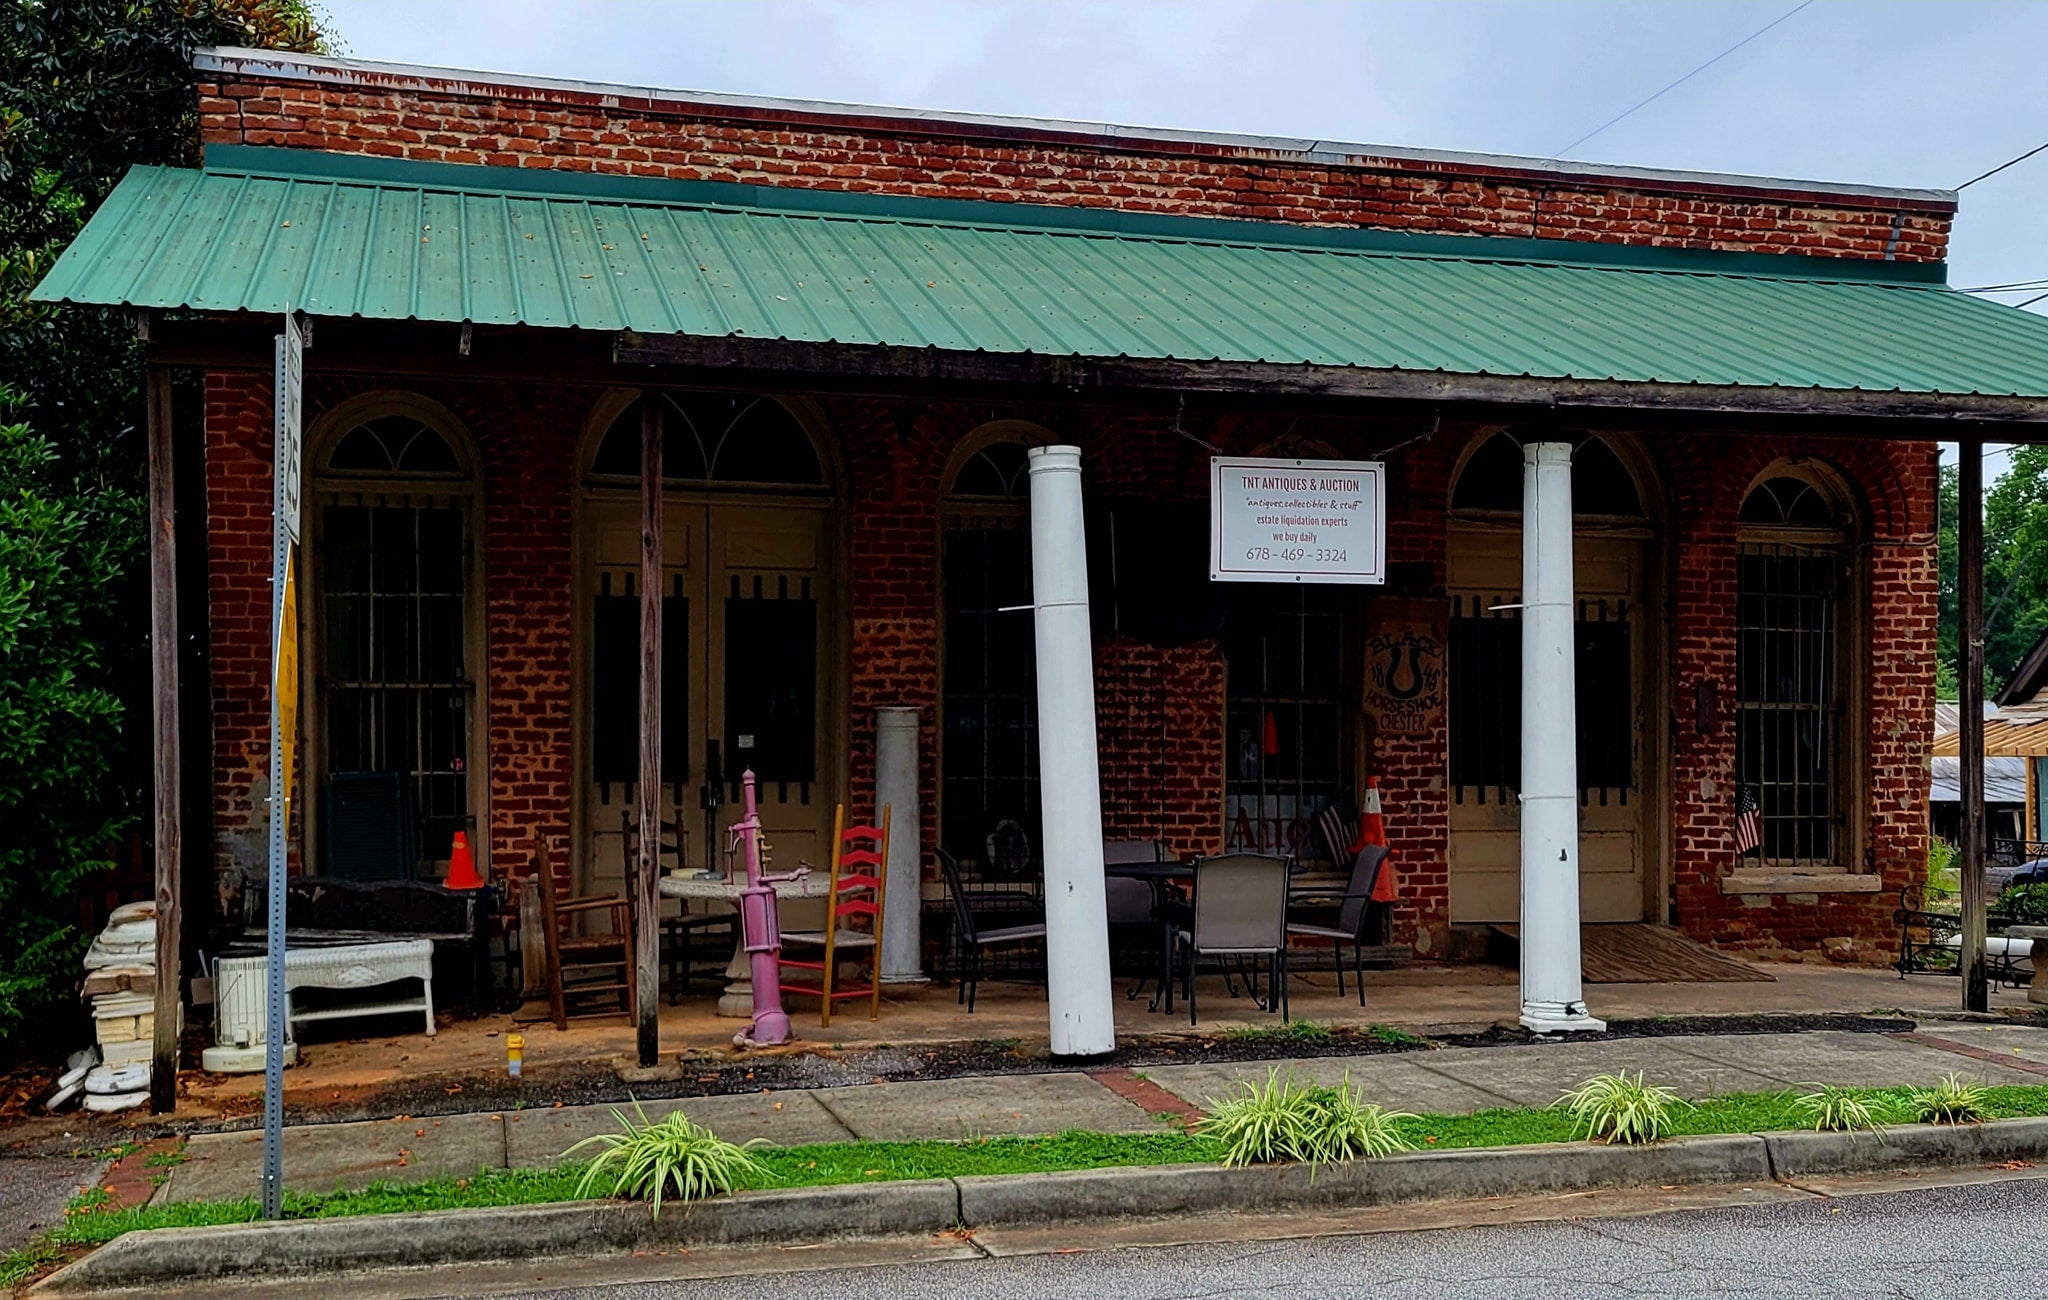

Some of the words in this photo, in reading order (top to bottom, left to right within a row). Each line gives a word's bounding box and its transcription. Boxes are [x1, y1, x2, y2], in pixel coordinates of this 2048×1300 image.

[286, 425, 299, 512] 25
[1242, 476, 1260, 489] TNT
[1262, 477, 1307, 492] ANTIQUES
[1309, 478, 1317, 491] &
[1320, 479, 1359, 492] AUCTION
[1330, 499, 1339, 510] &
[1256, 515, 1280, 525] estate
[1280, 514, 1320, 527] liquidation
[1321, 517, 1348, 528] experts
[1272, 533, 1284, 541] we
[1285, 531, 1298, 543] buy
[1299, 532, 1318, 544] daily
[1368, 631, 1443, 658] BLACK
[1371, 662, 1385, 688] 18
[1365, 689, 1442, 714] HORSESHOE
[1379, 713, 1426, 732] CHESTER
